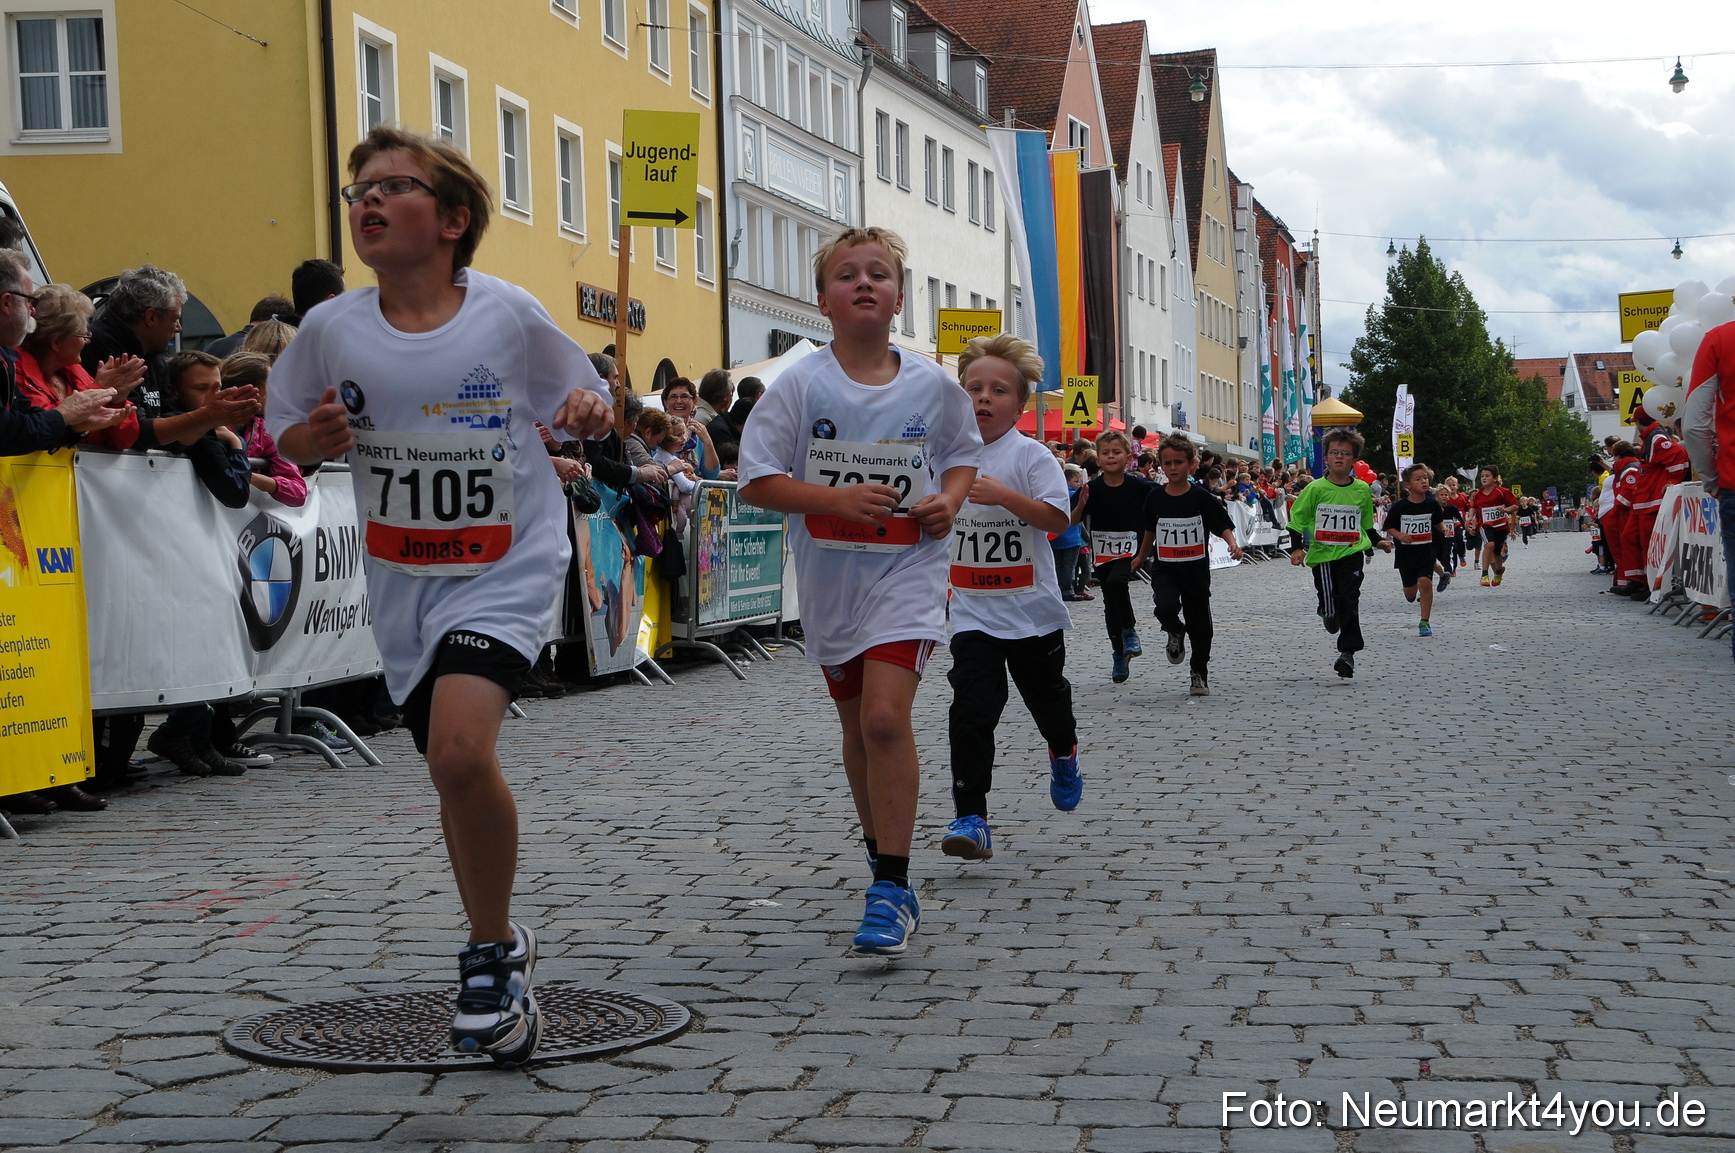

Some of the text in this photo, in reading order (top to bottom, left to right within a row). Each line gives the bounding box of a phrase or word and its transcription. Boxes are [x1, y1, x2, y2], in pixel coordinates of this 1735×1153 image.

[625, 141, 697, 164] Jugend-
[644, 164, 678, 182] lauf
[1623, 305, 1669, 318] Schnupp
[941, 322, 997, 334] Schnupper-
[1067, 378, 1094, 387] Block
[1622, 373, 1649, 384] Bloc
[1069, 391, 1090, 417] A
[357, 443, 486, 462] PARTL Neumarkt
[1401, 441, 1410, 452] B
[809, 449, 849, 463] PARTL
[852, 454, 908, 467] Neumarkt
[370, 466, 495, 522] 7105
[954, 517, 1015, 528] ARTL Neumarkt
[1321, 514, 1356, 530] 7110
[1404, 521, 1430, 534] 7205
[238, 512, 302, 558] BMW
[1161, 527, 1198, 545] 7111
[315, 525, 361, 582] BMW
[400, 536, 465, 559] Jonas
[956, 530, 1023, 563] 7126
[1097, 539, 1132, 555] 7119
[972, 571, 1001, 586] Luca
[304, 597, 360, 639] Weniger
